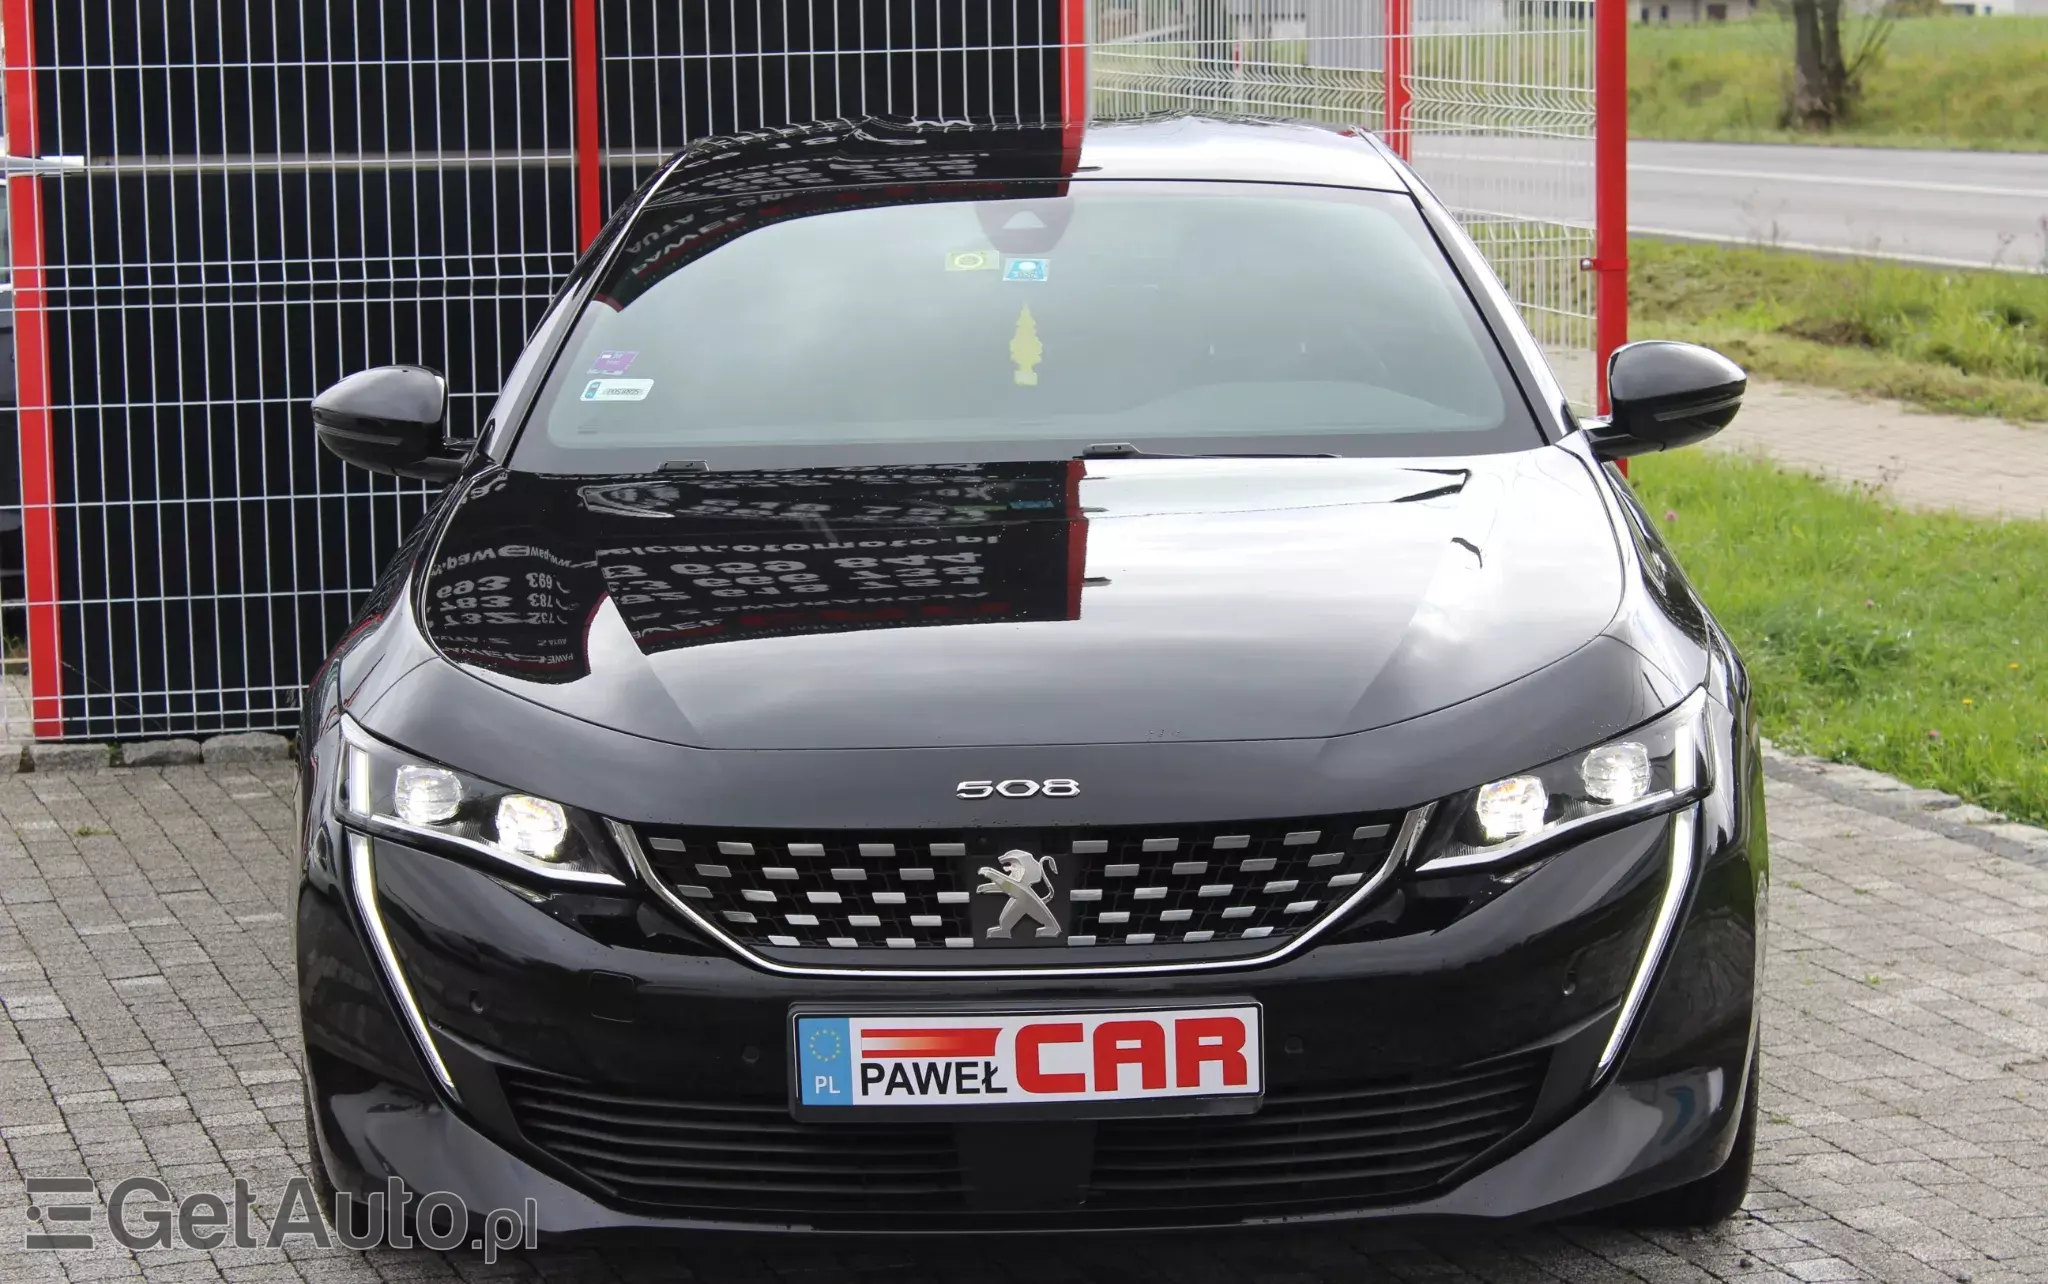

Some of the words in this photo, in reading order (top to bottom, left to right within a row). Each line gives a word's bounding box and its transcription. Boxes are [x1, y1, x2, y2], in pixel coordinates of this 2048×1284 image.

[956, 782, 1081, 799] 508
[1015, 1016, 1247, 1094] CAR
[814, 1075, 841, 1094] PL
[861, 1061, 1008, 1096] PAWEŁ
